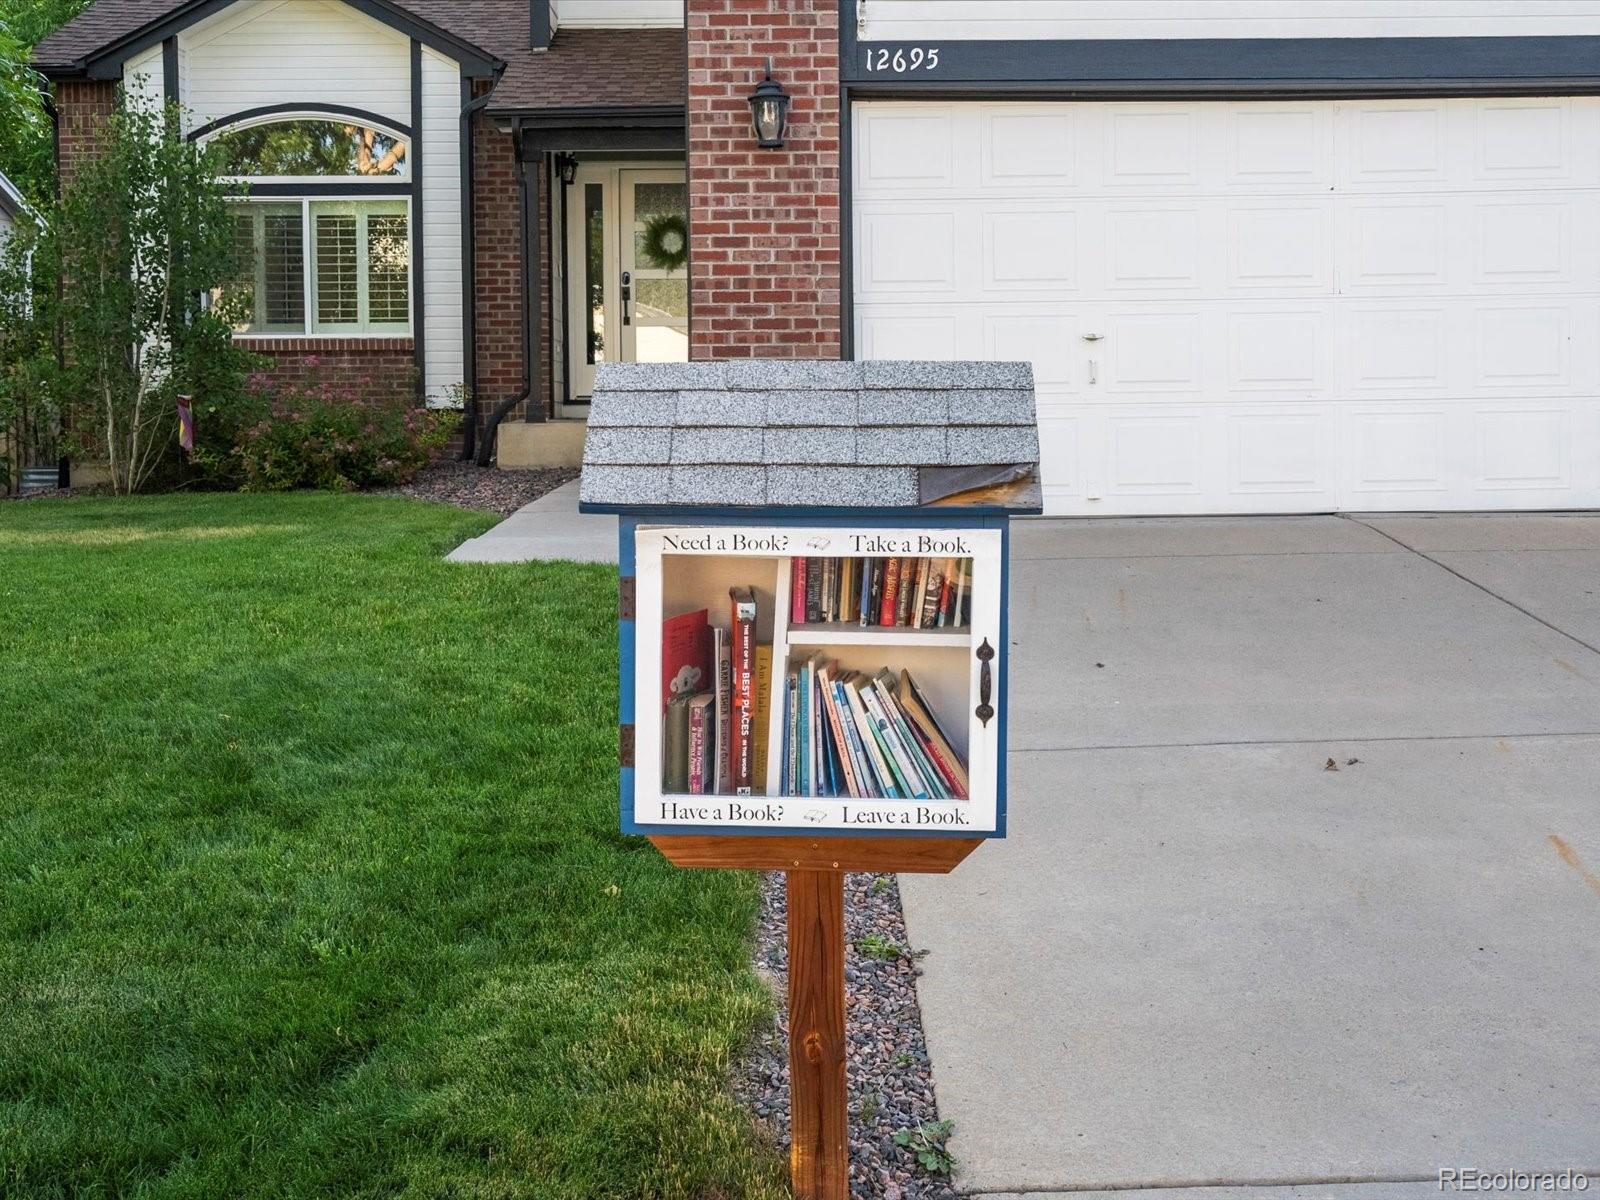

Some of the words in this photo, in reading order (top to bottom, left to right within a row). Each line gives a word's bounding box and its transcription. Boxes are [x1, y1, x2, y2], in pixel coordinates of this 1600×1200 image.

[867, 48, 939, 72] 12695
[662, 535, 710, 551] Need
[716, 540, 725, 551] a
[733, 534, 788, 551] Book?
[850, 535, 897, 553] Take
[902, 541, 911, 553] a
[918, 536, 972, 554] Book.
[743, 649, 749, 658] OF
[759, 665, 767, 679] Am
[741, 672, 750, 696] BEST
[758, 682, 767, 712] Malala
[741, 699, 750, 736] PLACES
[661, 803, 709, 820] Have
[712, 809, 722, 821] a
[729, 804, 784, 822] Book?
[842, 806, 895, 825] Leave
[901, 812, 910, 825] a
[916, 807, 970, 825] Book.
